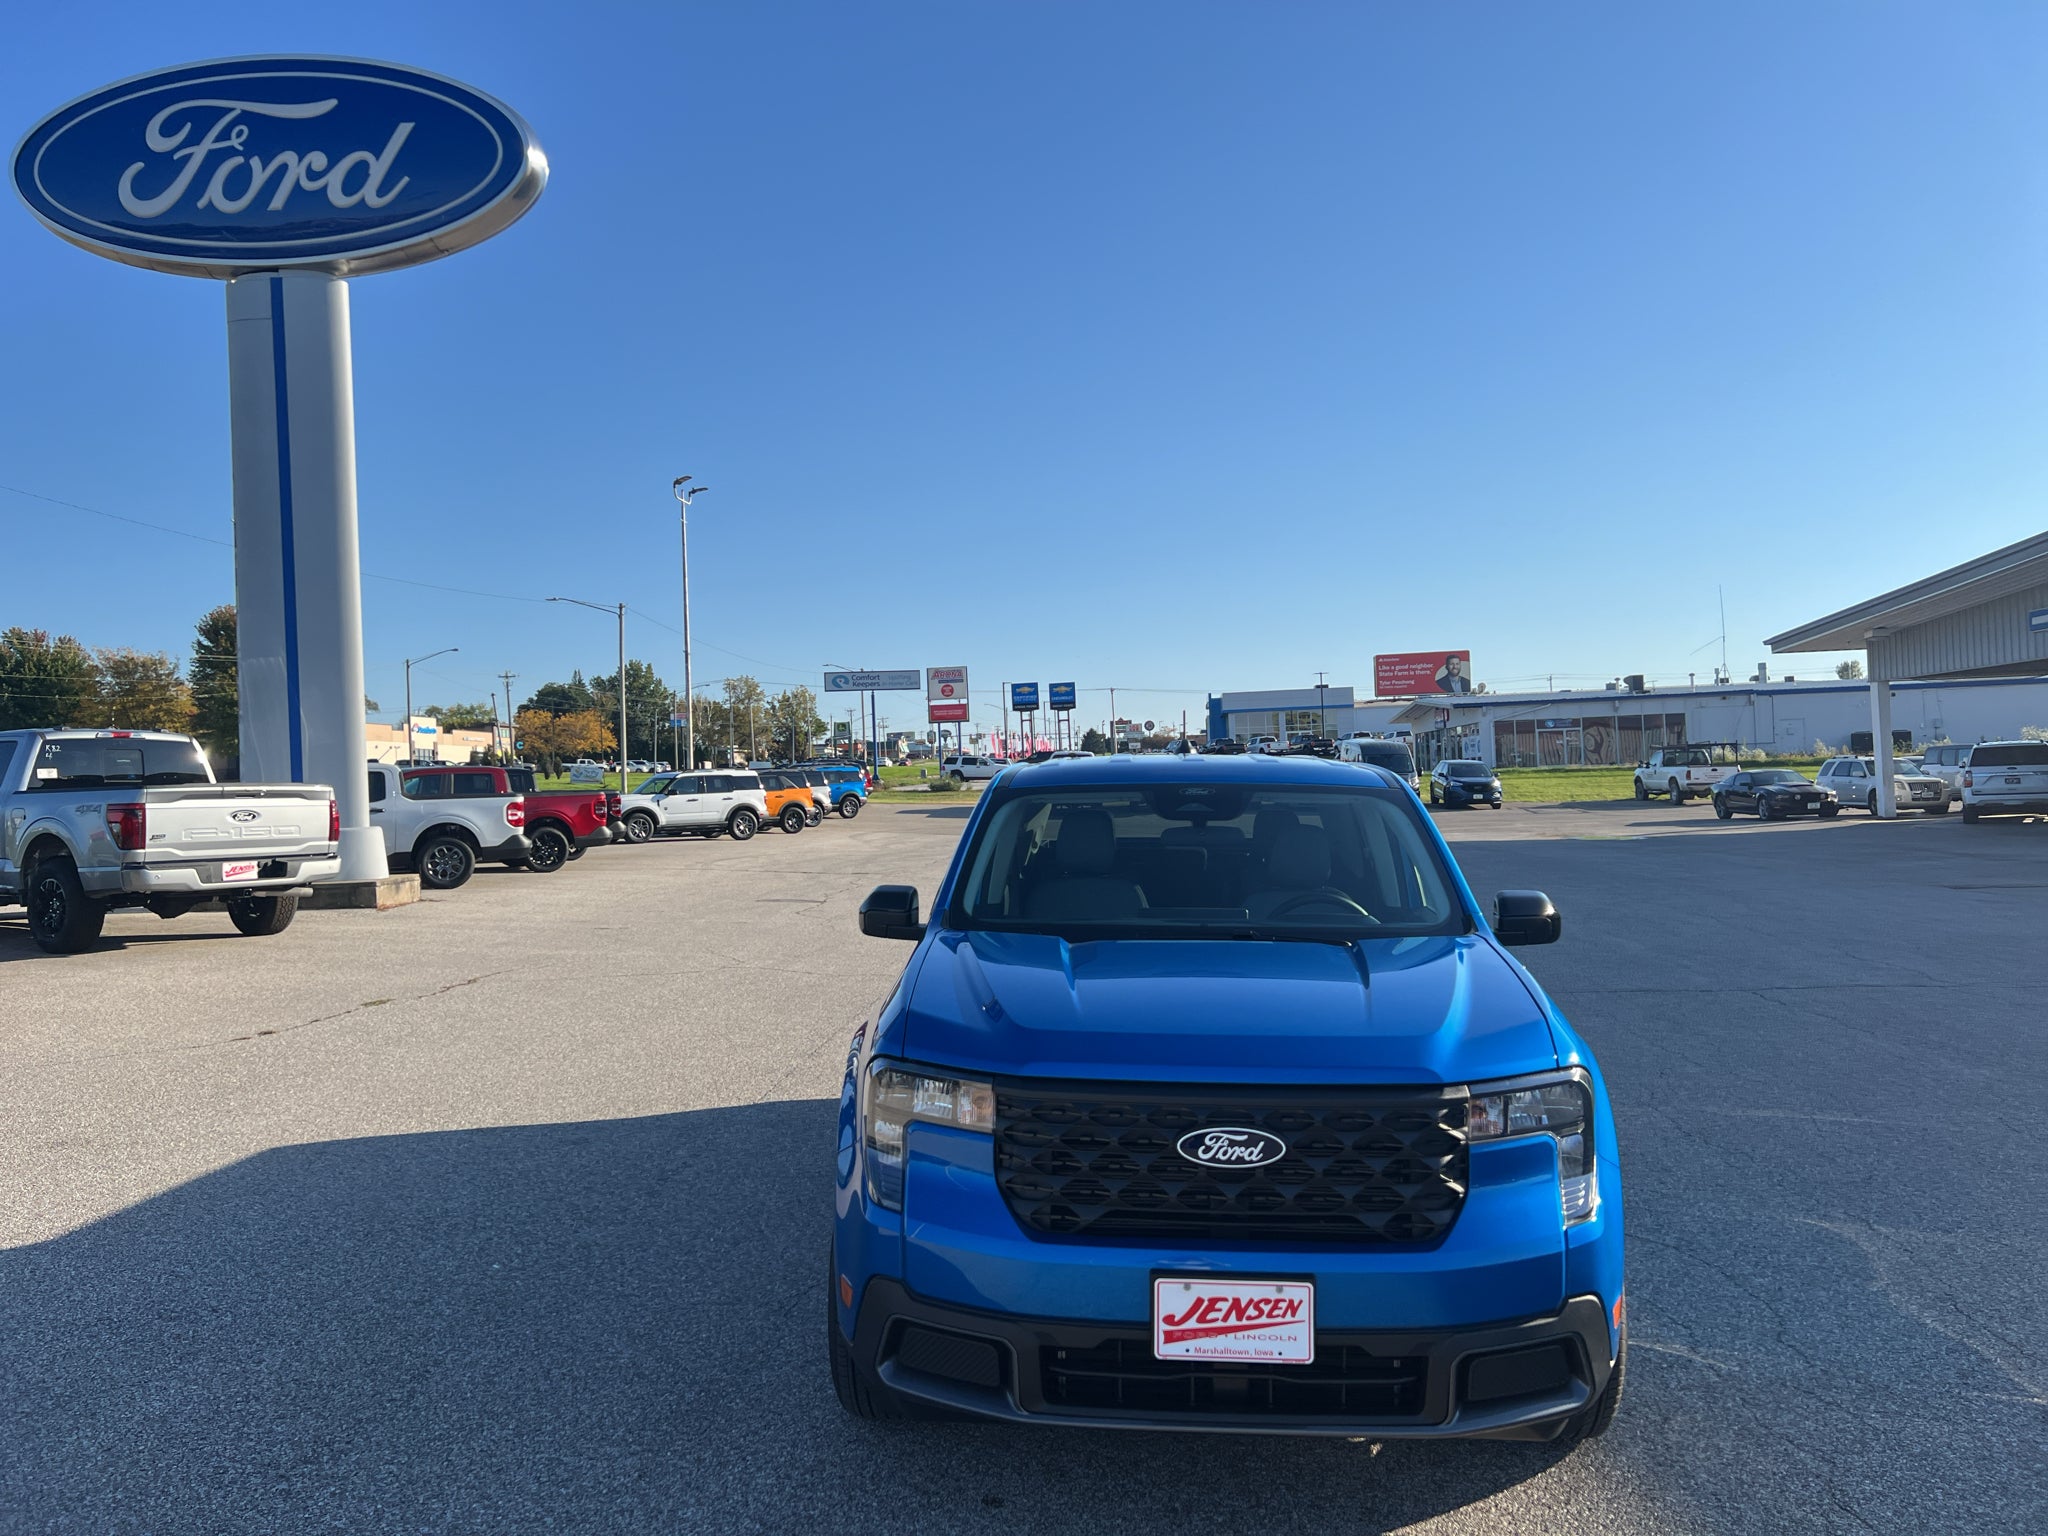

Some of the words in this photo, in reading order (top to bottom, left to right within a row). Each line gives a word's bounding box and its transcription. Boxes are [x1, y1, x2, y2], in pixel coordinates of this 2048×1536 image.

[118, 98, 415, 218] Ford
[182, 825, 301, 840] F-150
[1198, 1132, 1265, 1162] Ford
[1162, 1296, 1303, 1326] JENSEN
[1234, 1334, 1298, 1342] LINCOLN
[1194, 1346, 1252, 1357] Marshalltown,
[1254, 1348, 1274, 1356] Iowa
